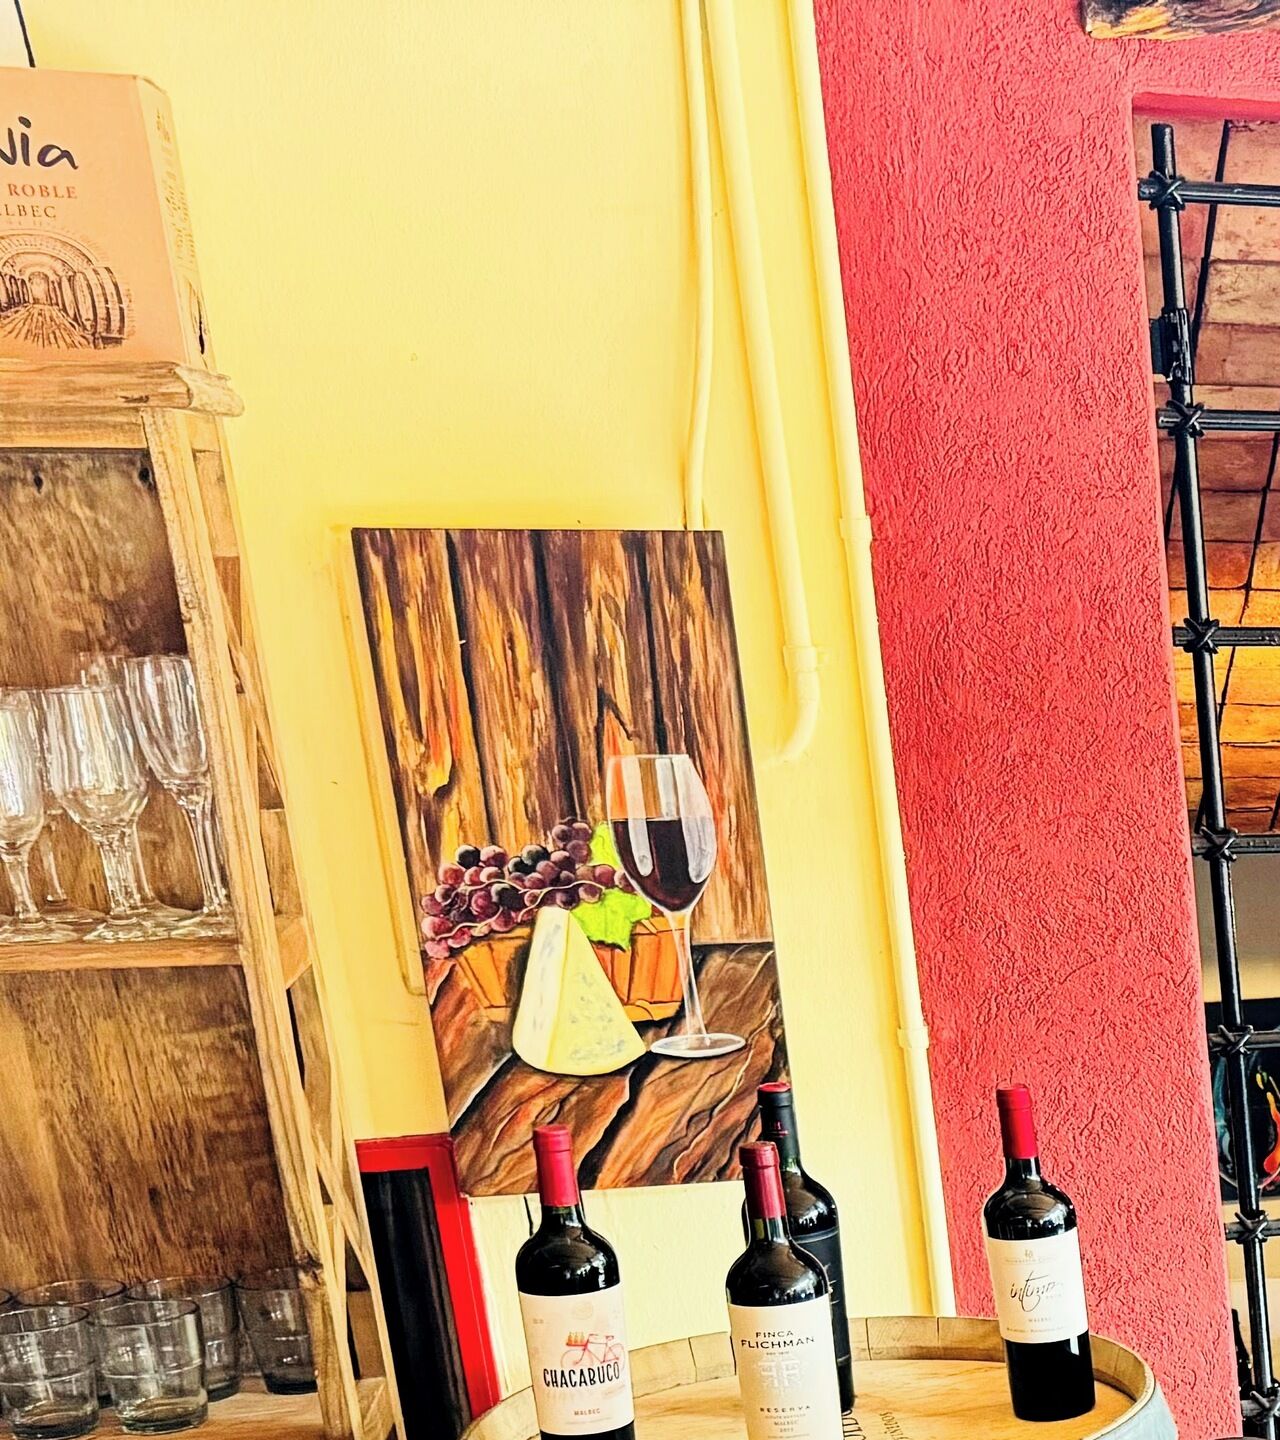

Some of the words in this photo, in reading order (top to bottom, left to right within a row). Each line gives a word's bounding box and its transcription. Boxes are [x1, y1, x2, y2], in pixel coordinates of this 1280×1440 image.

[8, 183, 78, 199] ROBLE
[0, 203, 57, 219] LBEC
[755, 1330, 794, 1338] FINCA
[741, 1336, 815, 1349] FLICHMAN
[543, 1361, 620, 1388] CHACABUCO
[574, 1408, 601, 1416] MALBEC
